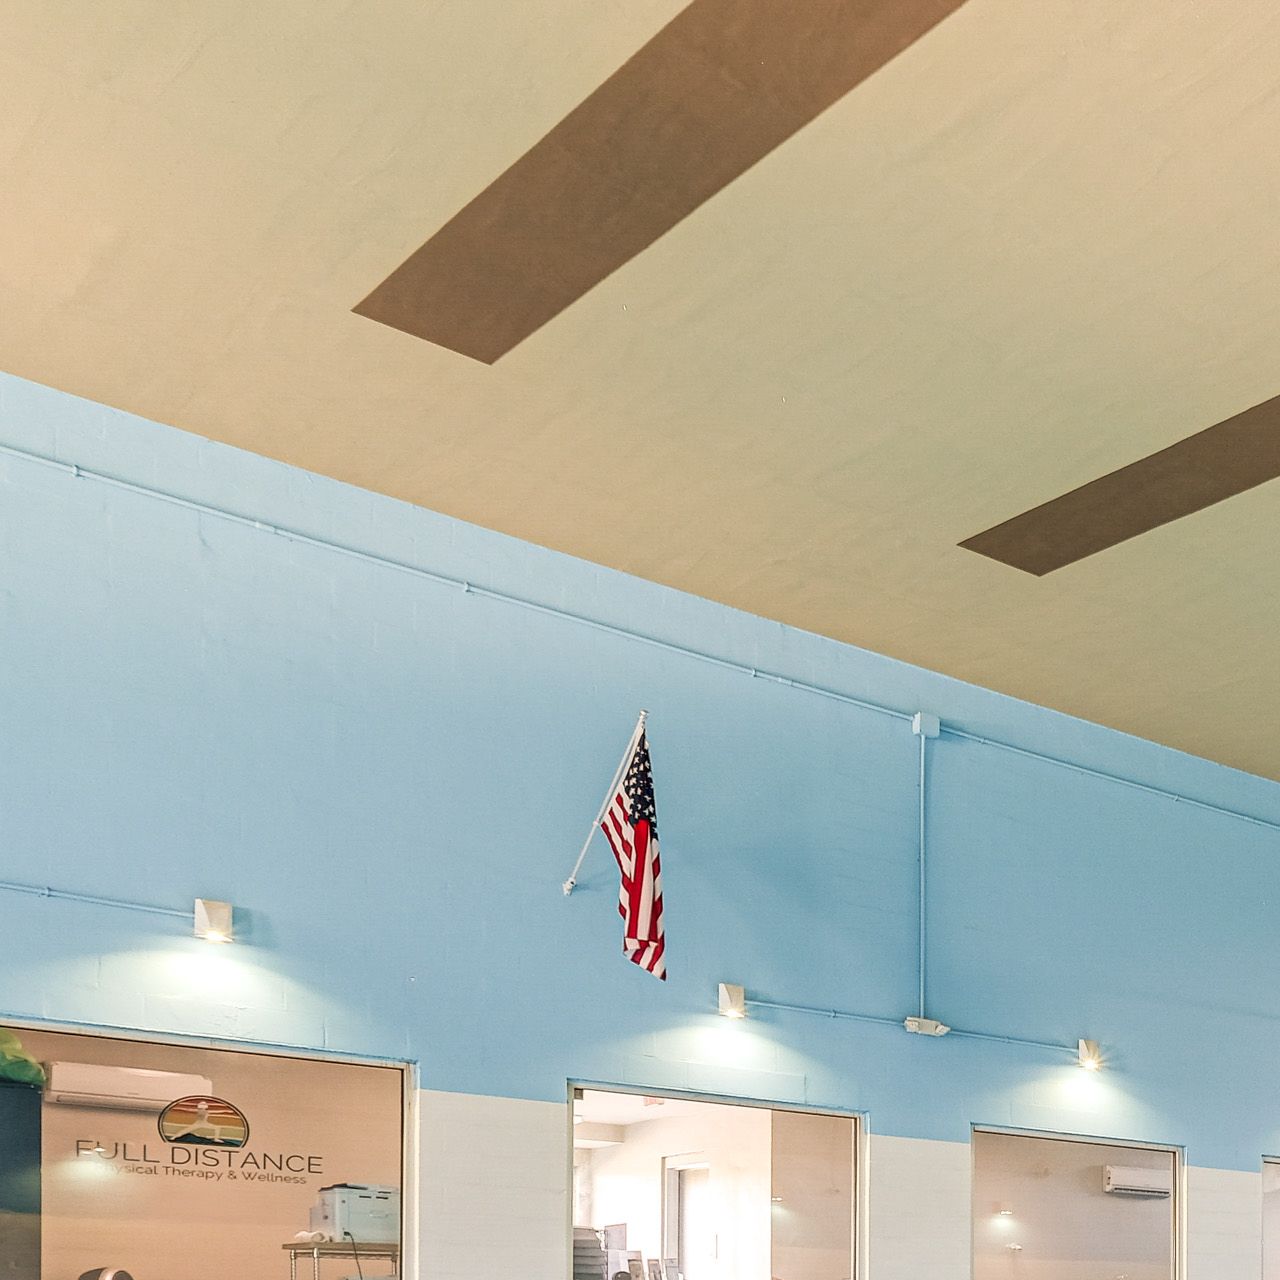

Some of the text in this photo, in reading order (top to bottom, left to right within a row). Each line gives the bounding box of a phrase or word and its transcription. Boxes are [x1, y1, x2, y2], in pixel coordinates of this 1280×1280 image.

[75, 1140, 323, 1174] FULL DISTANCE
[102, 1161, 307, 1184] ysical Therapy & Wellness
